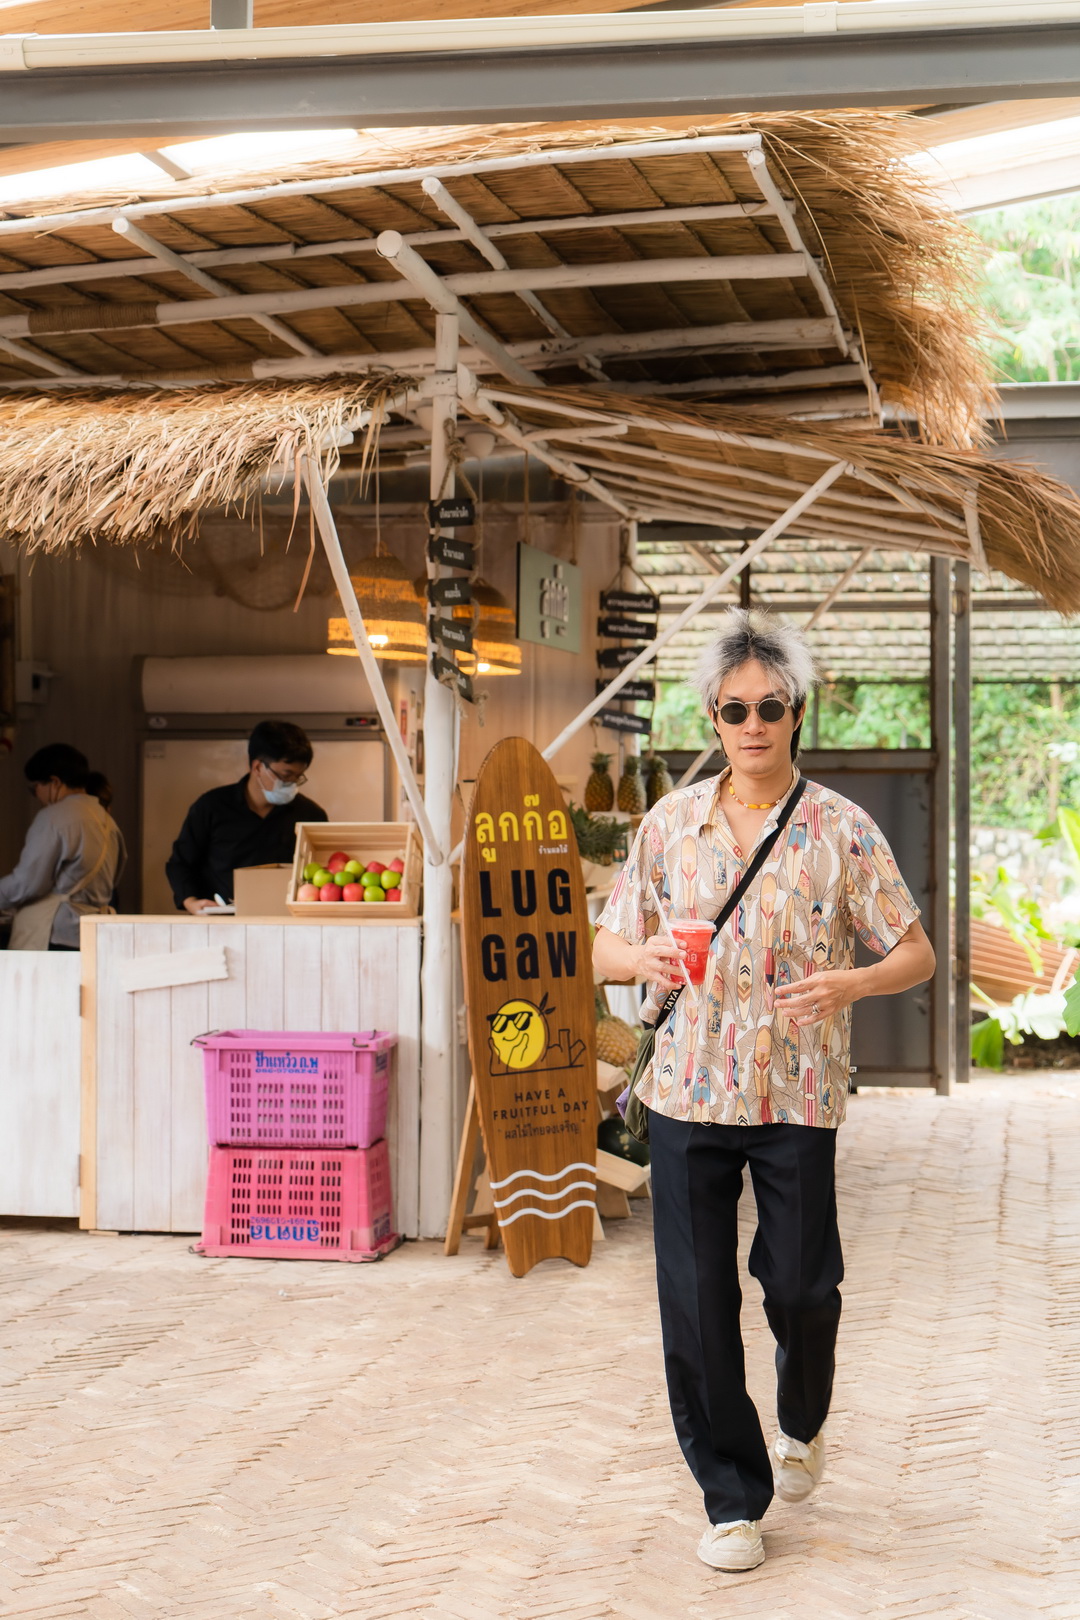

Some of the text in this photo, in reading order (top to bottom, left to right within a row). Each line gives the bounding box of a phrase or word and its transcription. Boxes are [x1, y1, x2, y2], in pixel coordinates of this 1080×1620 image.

[475, 794, 568, 863] ลูกก๊อ
[479, 868, 572, 918] LUG
[514, 1088, 566, 1103] HAVE A
[493, 1100, 589, 1120] FRUITFUL DAY
[250, 1219, 319, 1242] ลูกตาล
